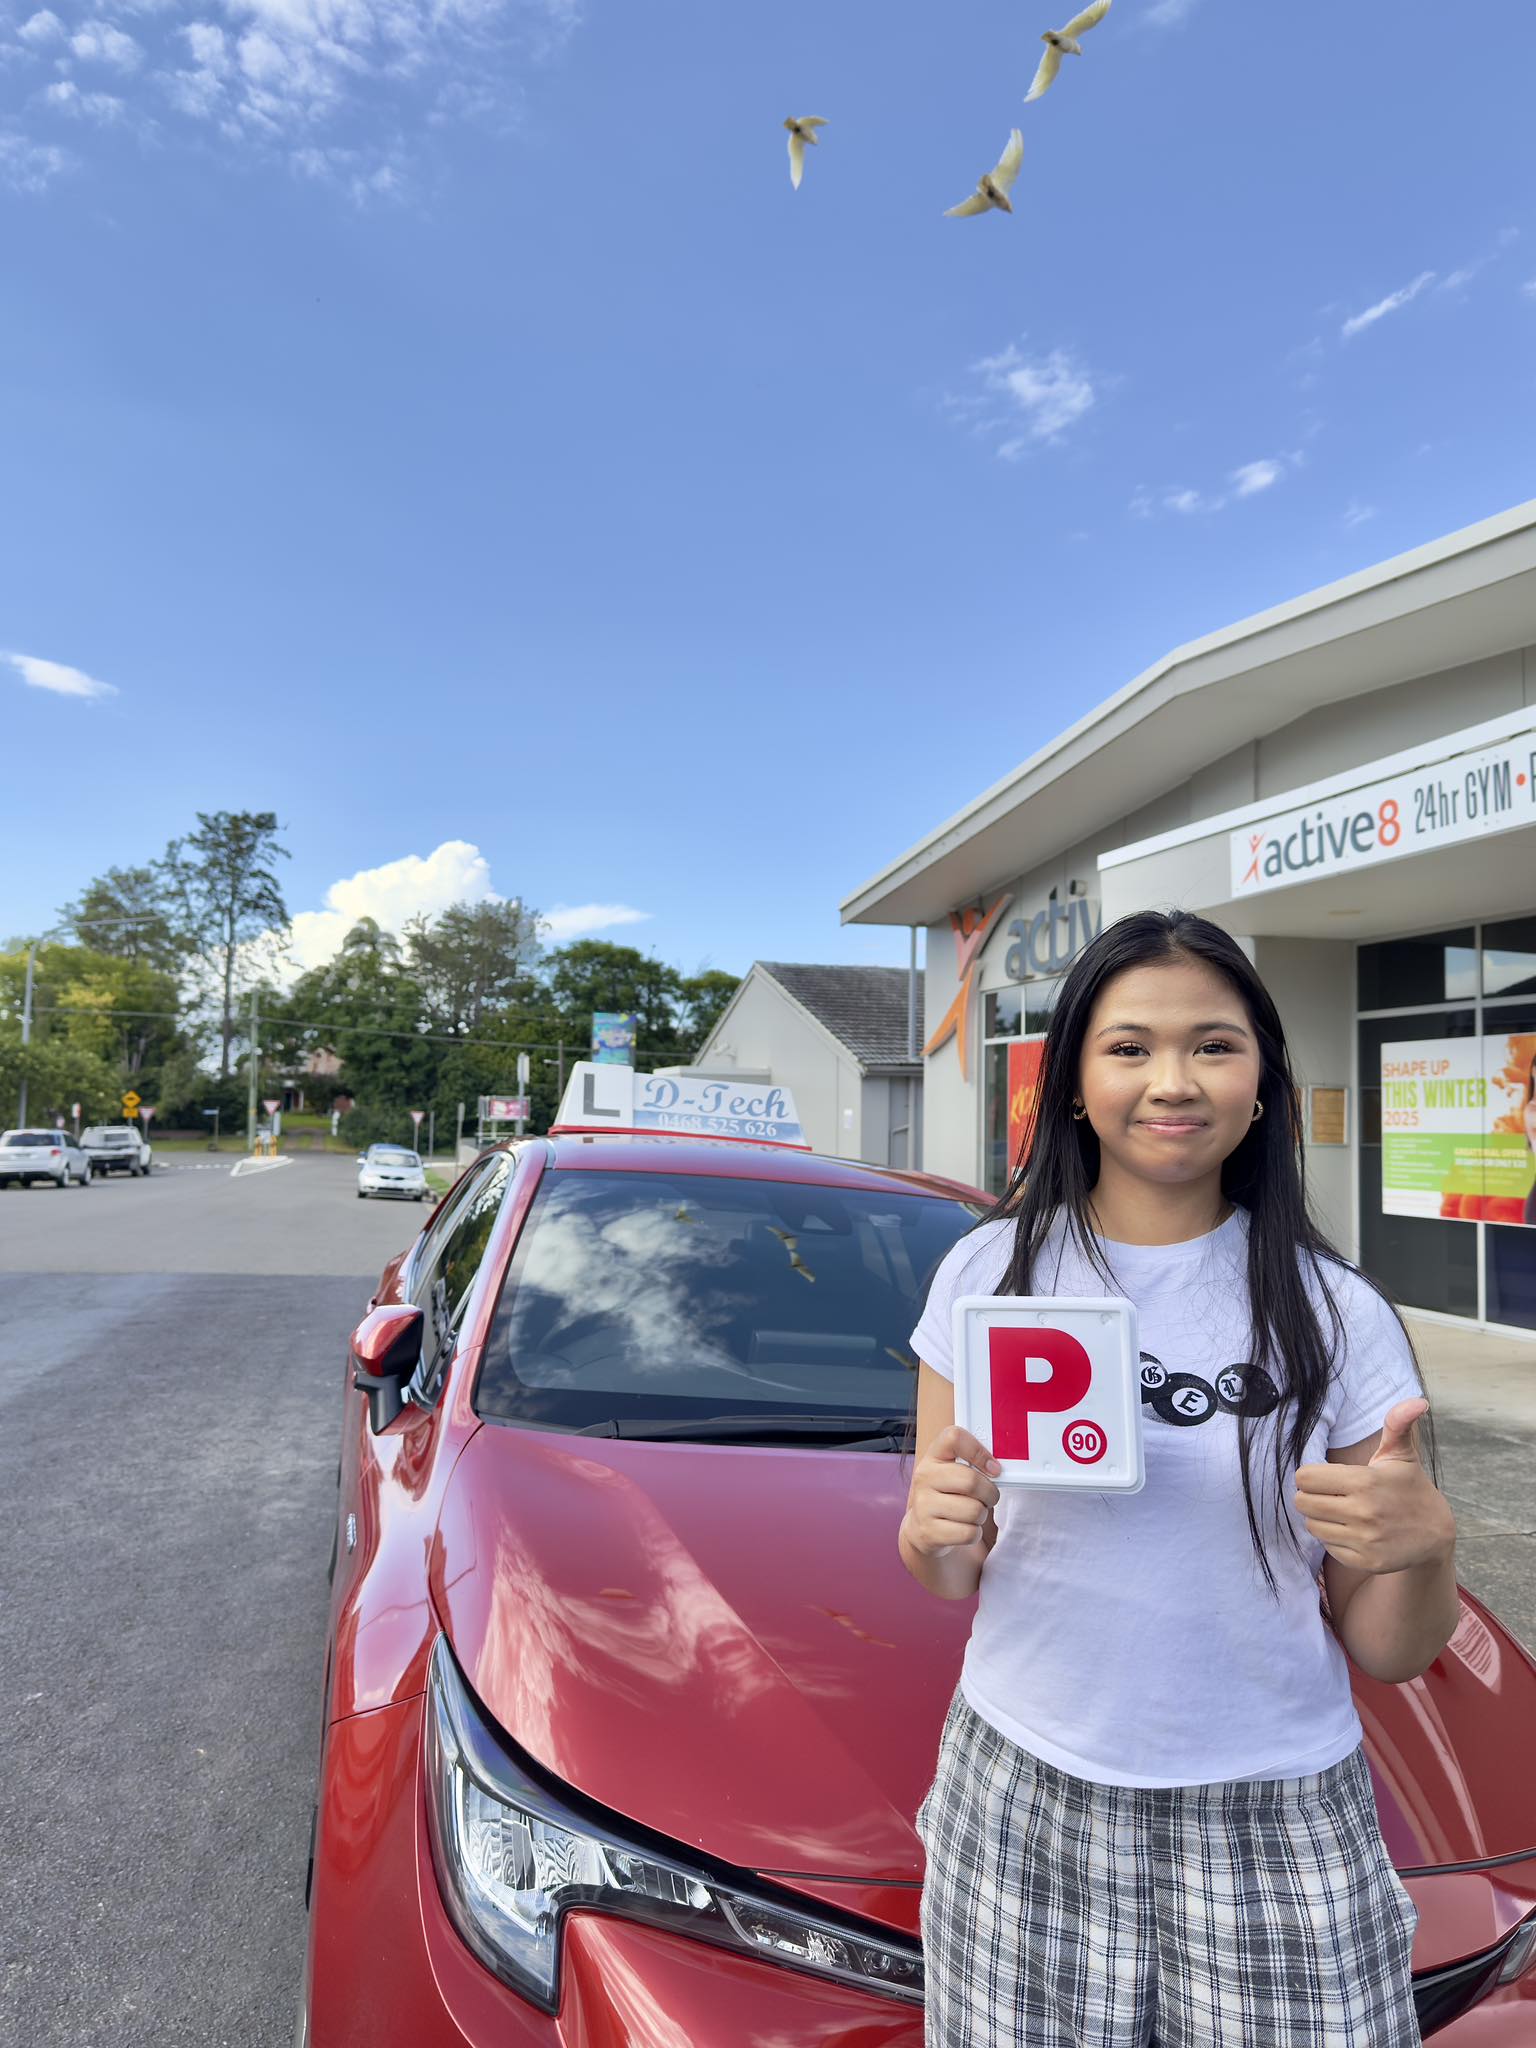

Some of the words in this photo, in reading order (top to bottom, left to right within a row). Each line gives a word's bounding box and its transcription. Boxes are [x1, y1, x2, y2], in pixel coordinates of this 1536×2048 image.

[1263, 799, 1402, 878] active8
[1414, 779, 1460, 835] 24hr
[1465, 760, 1512, 820] GYM
[1383, 1061, 1427, 1077] SHAPE
[1431, 1059, 1450, 1075] UP
[583, 1073, 621, 1118] L
[643, 1077, 790, 1119] D-Tech
[1383, 1079, 1418, 1108] THIS
[1424, 1078, 1488, 1108] WINTER
[657, 1113, 703, 1130] 0468
[708, 1117, 740, 1134] 525
[745, 1121, 777, 1137] 626
[1383, 1110, 1420, 1126] 2025
[988, 1326, 1092, 1460] P
[1071, 1433, 1097, 1452] 90
